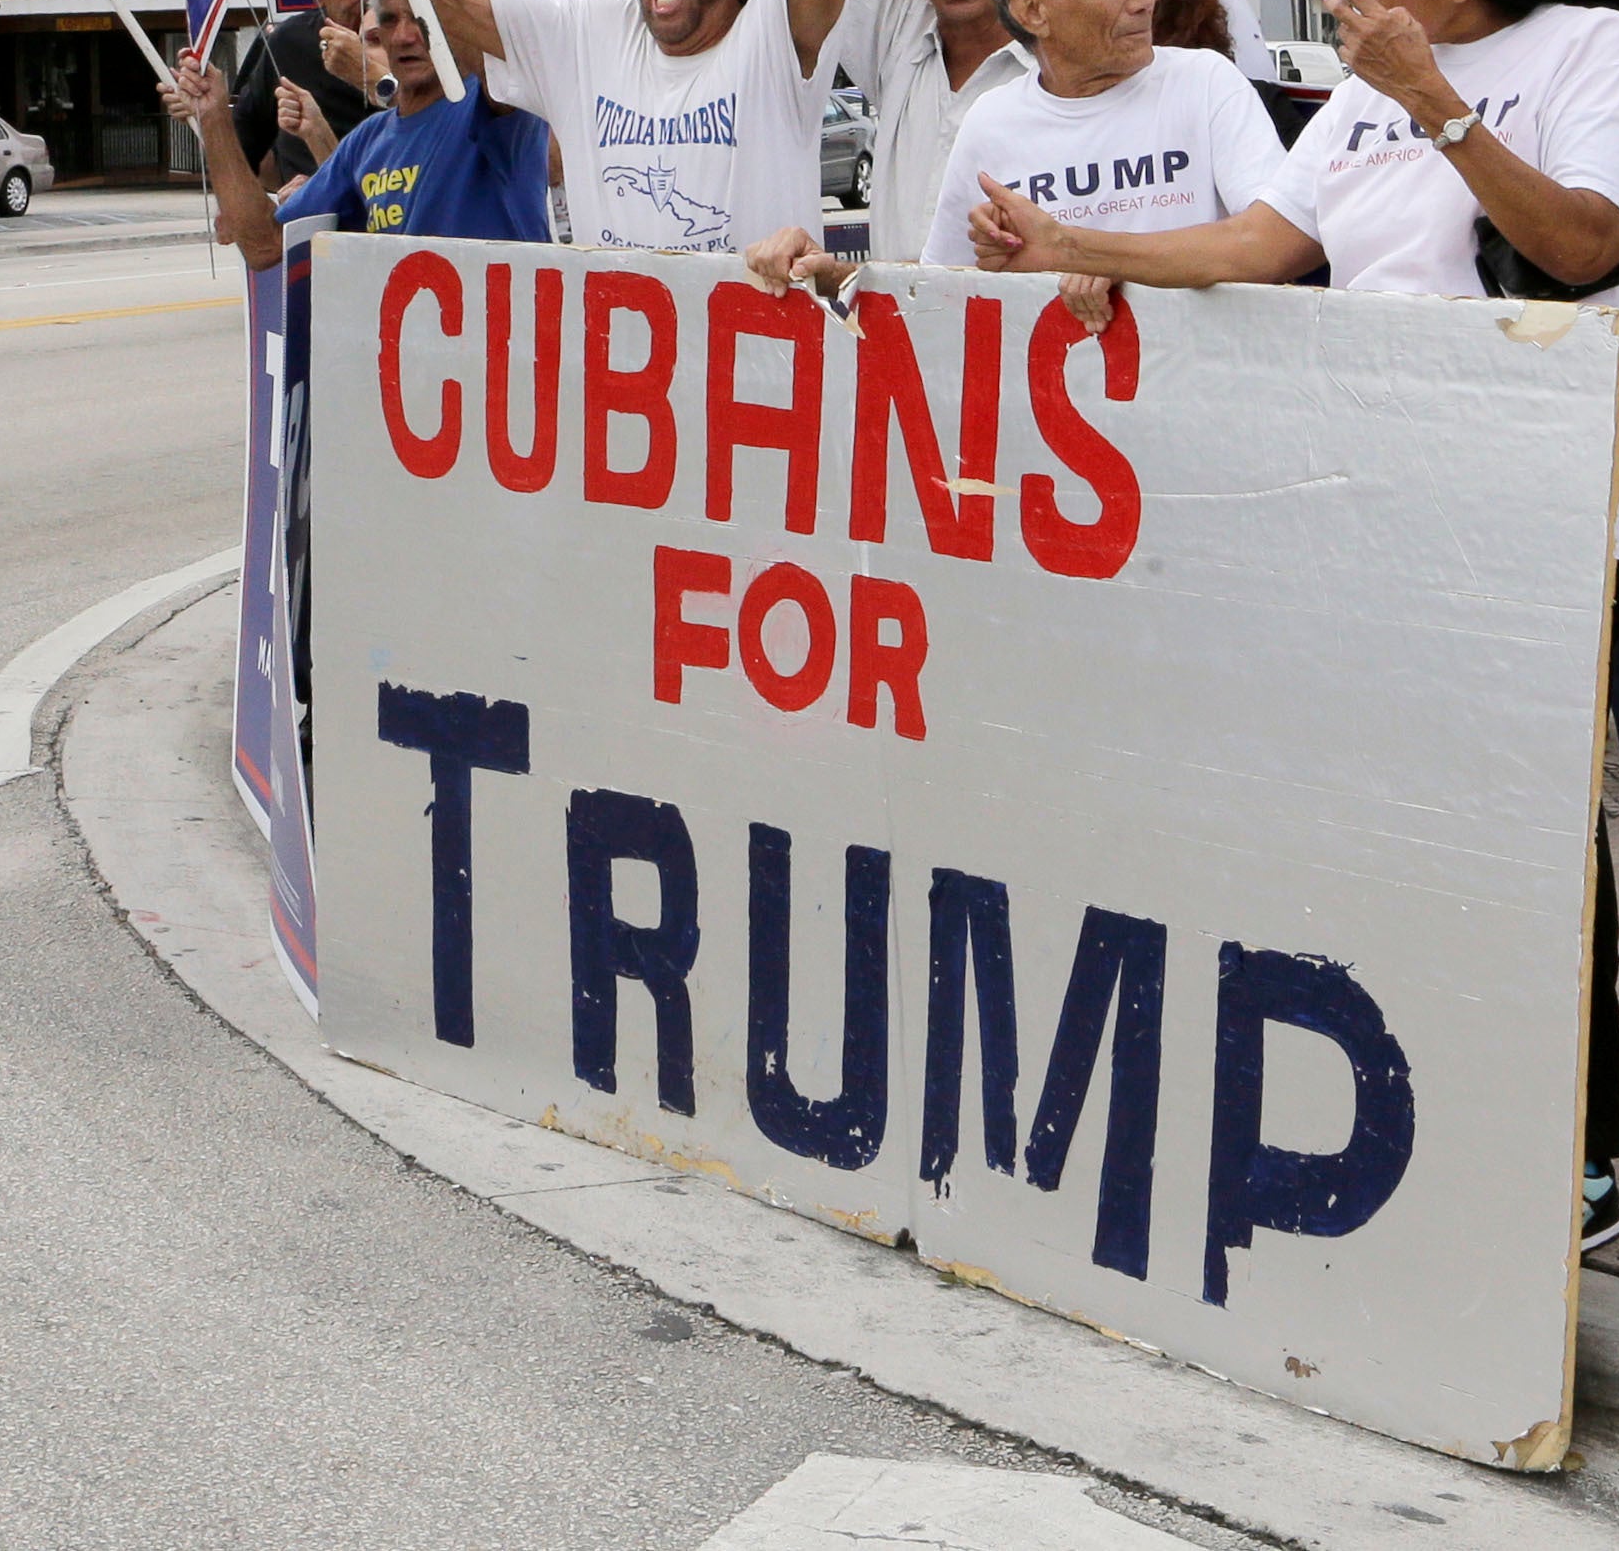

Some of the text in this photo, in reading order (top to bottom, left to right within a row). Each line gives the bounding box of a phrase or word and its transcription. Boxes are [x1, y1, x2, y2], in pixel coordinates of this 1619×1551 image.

[595, 94, 655, 148] VIGILIA
[1097, 196, 1145, 216] GREAT
[1150, 191, 1195, 208] AGAIN!
[379, 249, 1143, 579] CUBANS
[652, 545, 927, 741] FOR
[377, 678, 1417, 1311] TRUMP
